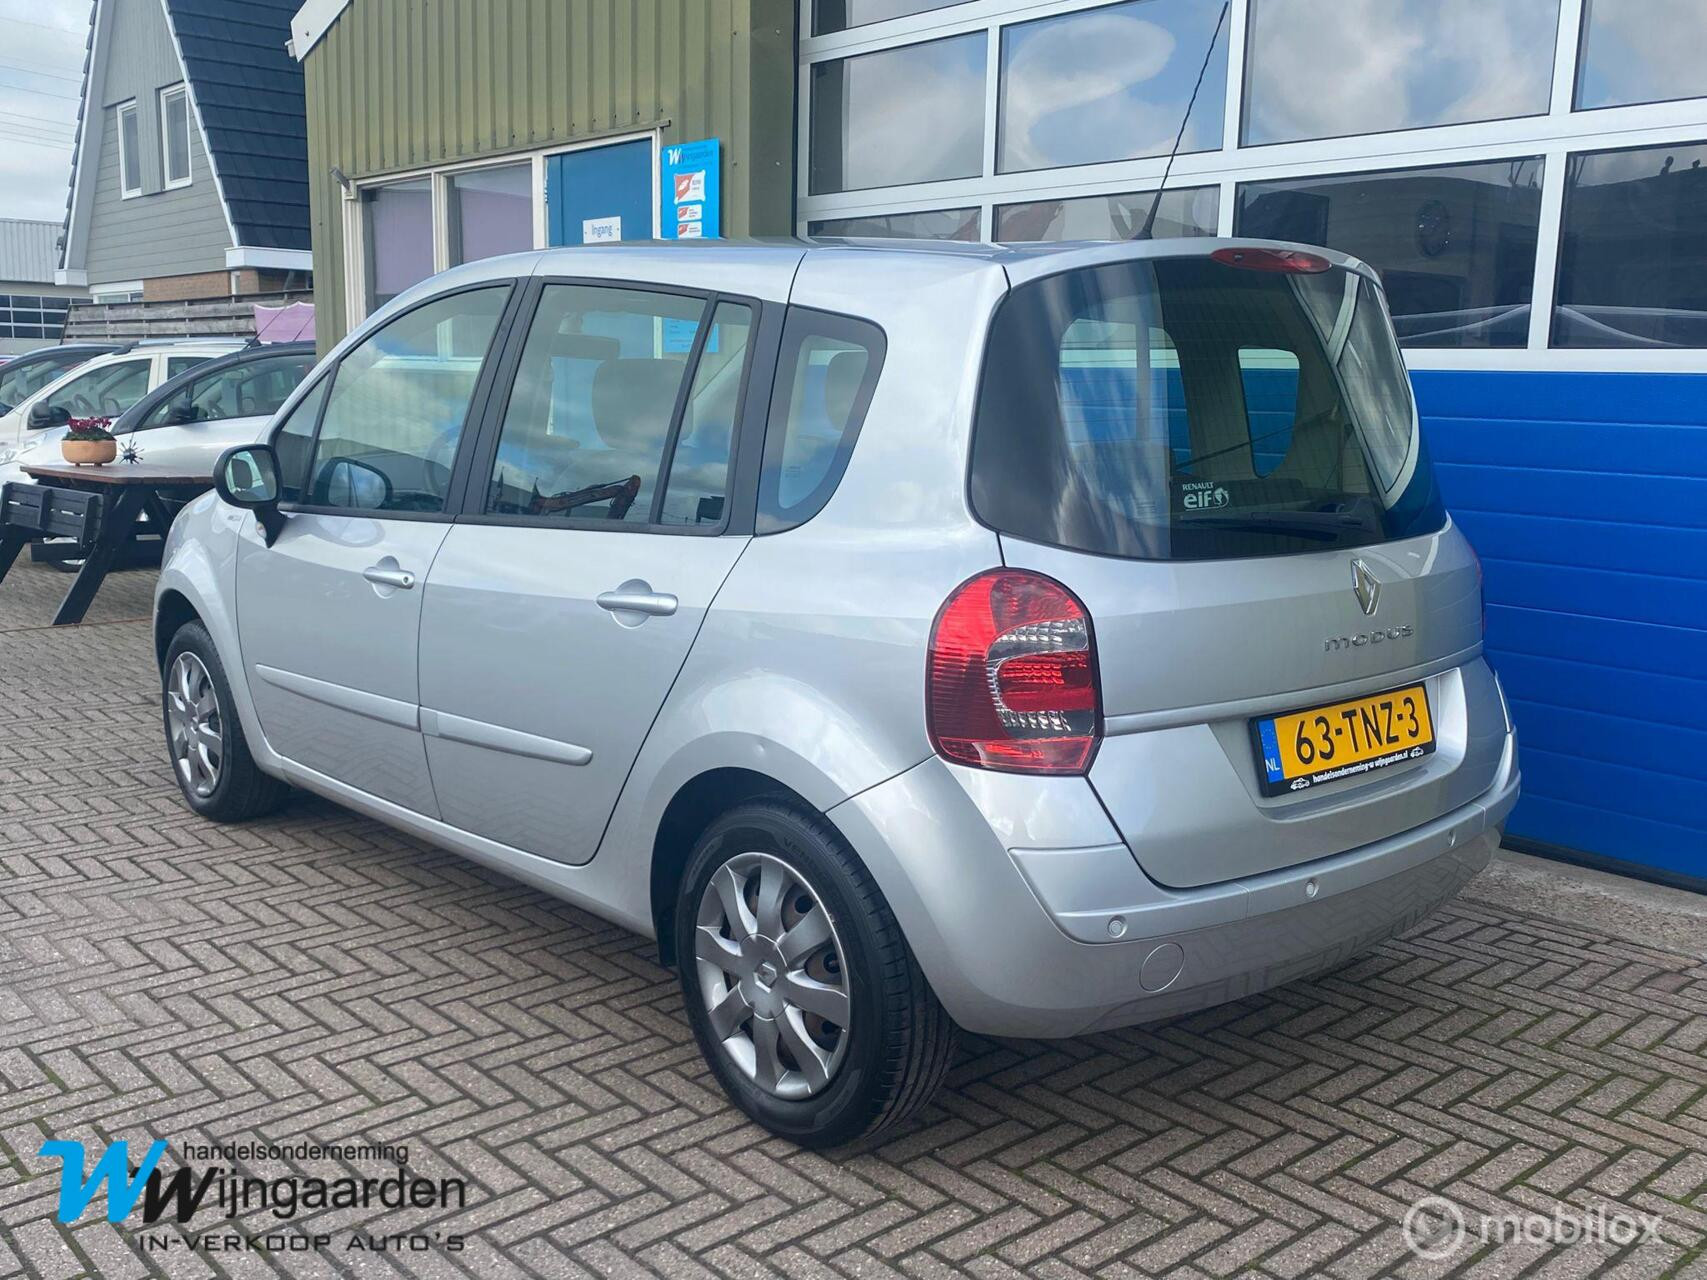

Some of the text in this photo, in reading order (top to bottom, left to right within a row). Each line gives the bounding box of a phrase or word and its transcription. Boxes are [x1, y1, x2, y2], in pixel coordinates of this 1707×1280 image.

[591, 223, 613, 238] Ingang
[1182, 481, 1214, 491] RENAULT
[1183, 490, 1212, 509] elf
[1294, 696, 1420, 765] 63-TNZ-3
[1265, 758, 1281, 773] NL
